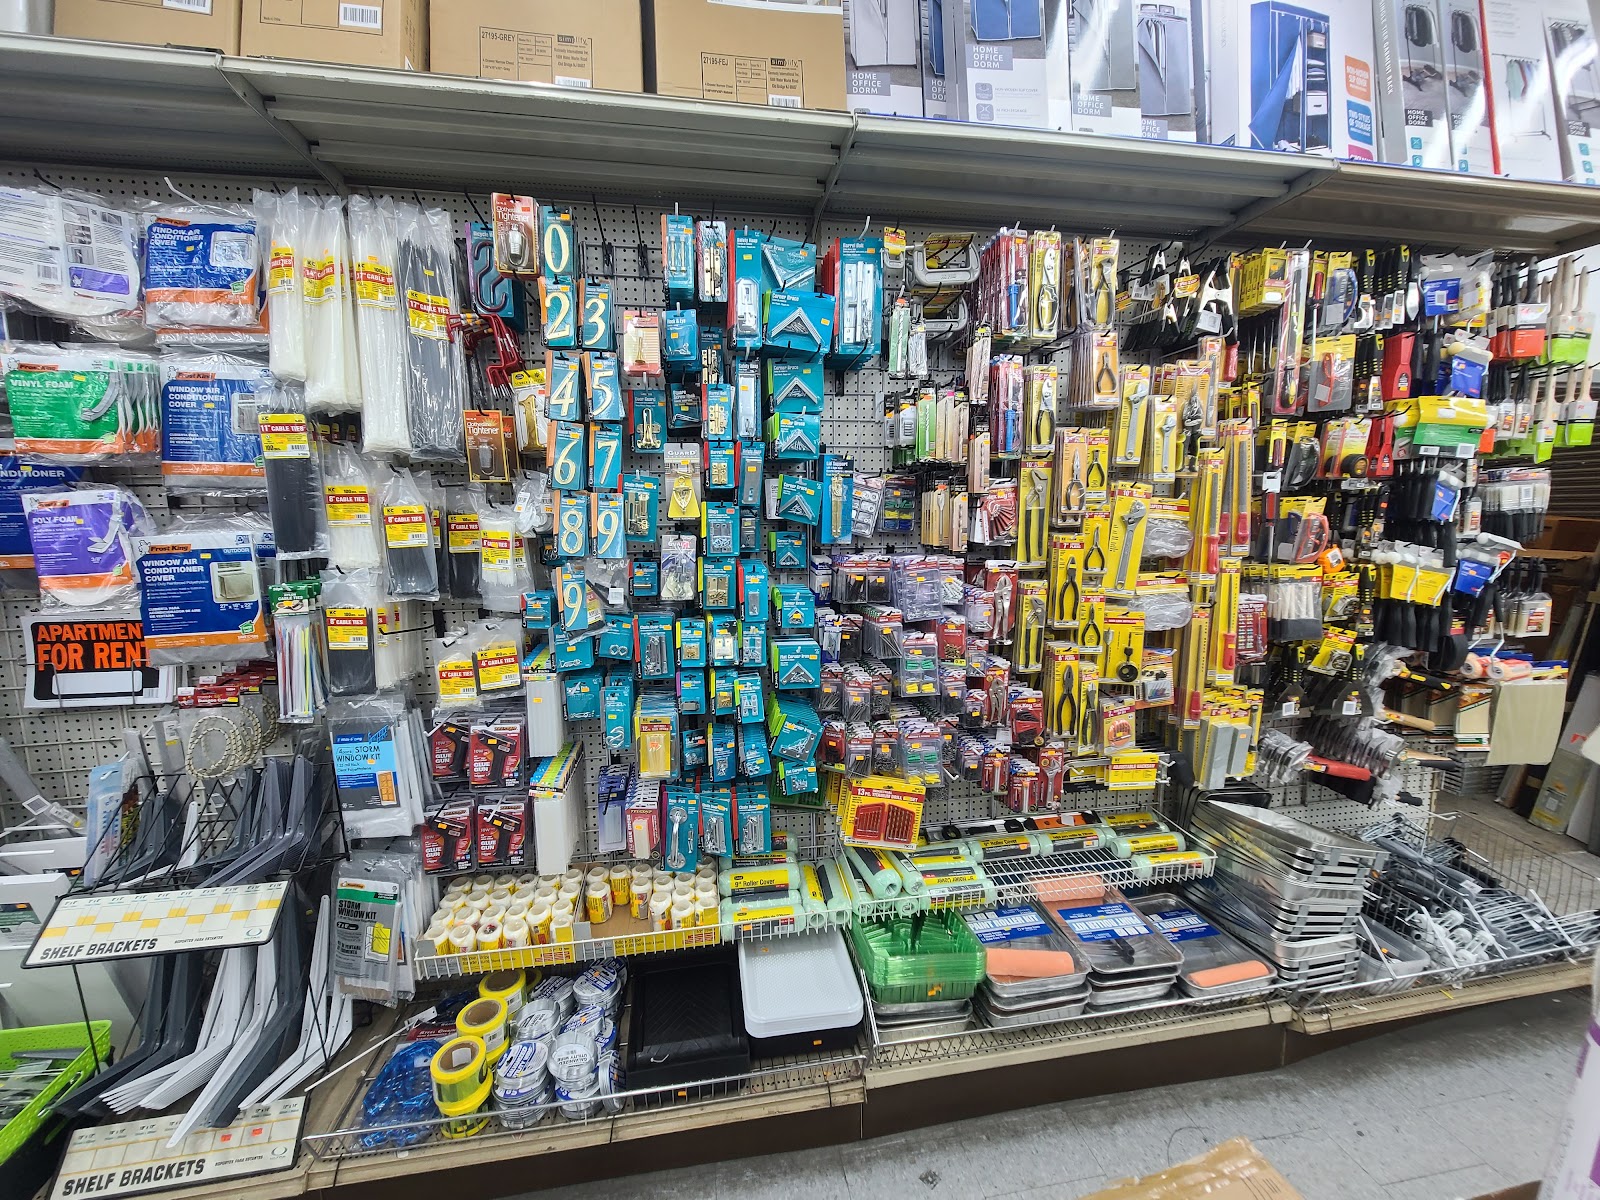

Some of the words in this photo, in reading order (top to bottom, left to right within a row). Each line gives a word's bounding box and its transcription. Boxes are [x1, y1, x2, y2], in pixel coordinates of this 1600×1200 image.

[482, 31, 515, 42] 27195-GREY
[1382, 41, 1392, 74] GARMENT
[498, 211, 530, 222] Tightener
[772, 292, 786, 300] Corner
[786, 294, 799, 302] Brace
[410, 300, 419, 309] 17"
[420, 303, 436, 312] CABLE
[438, 306, 449, 314] TIES
[545, 291, 570, 340] 2
[584, 298, 606, 346] 3
[10, 379, 43, 387] VINYL
[168, 393, 226, 401] CONDITIONER
[550, 370, 575, 417] 4
[591, 370, 614, 416] 5
[467, 426, 499, 435] Tightener
[554, 439, 578, 485] 6
[596, 440, 618, 485] 7
[560, 509, 583, 554] 8
[597, 509, 619, 555] 9
[142, 559, 181, 567] WINDOW
[144, 566, 204, 574] CONDITIONER
[564, 583, 583, 627] 9
[37, 643, 84, 671] FOR
[857, 788, 865, 796] 13
[339, 900, 360, 909] STORM
[338, 908, 365, 919] WINDOW
[366, 911, 377, 919] KIT
[1115, 915, 1142, 926] PAINT
[968, 922, 994, 931] PAINT
[994, 917, 1022, 929] ROLLER
[1024, 914, 1039, 923] KIT
[1071, 921, 1088, 931] KIT
[40, 946, 84, 961] SHELF
[86, 938, 158, 956] BRACKETS
[62, 1172, 115, 1196] SHELF
[119, 1159, 206, 1187] BRACKETS
